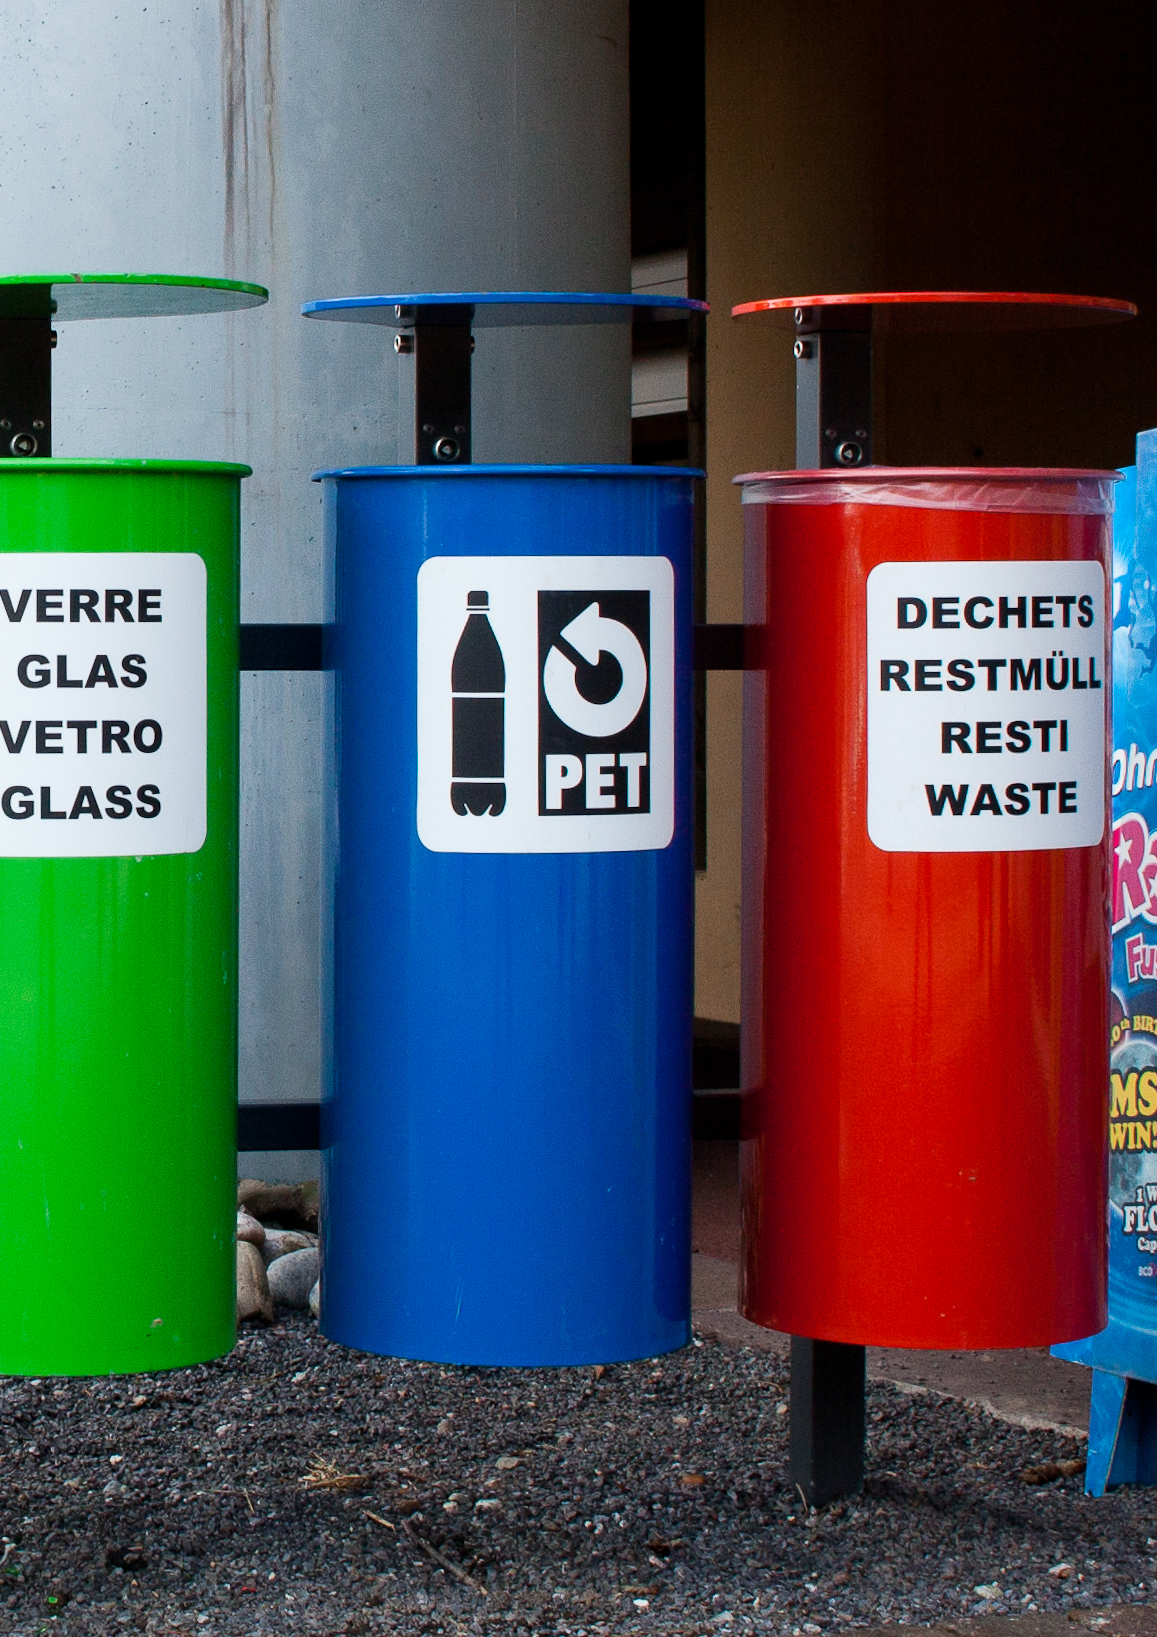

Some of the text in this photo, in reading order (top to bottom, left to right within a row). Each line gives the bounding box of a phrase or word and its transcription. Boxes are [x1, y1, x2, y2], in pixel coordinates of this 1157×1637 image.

[897, 595, 1094, 630] DECHETS
[18, 655, 147, 689] GLAS
[880, 651, 1101, 692] RESTMÜLL
[941, 719, 1067, 754] RESTI
[546, 752, 647, 810] PET
[924, 781, 1078, 816] WASTE
[1, 785, 161, 819] GLASS
[1125, 932, 1157, 983] Fu
